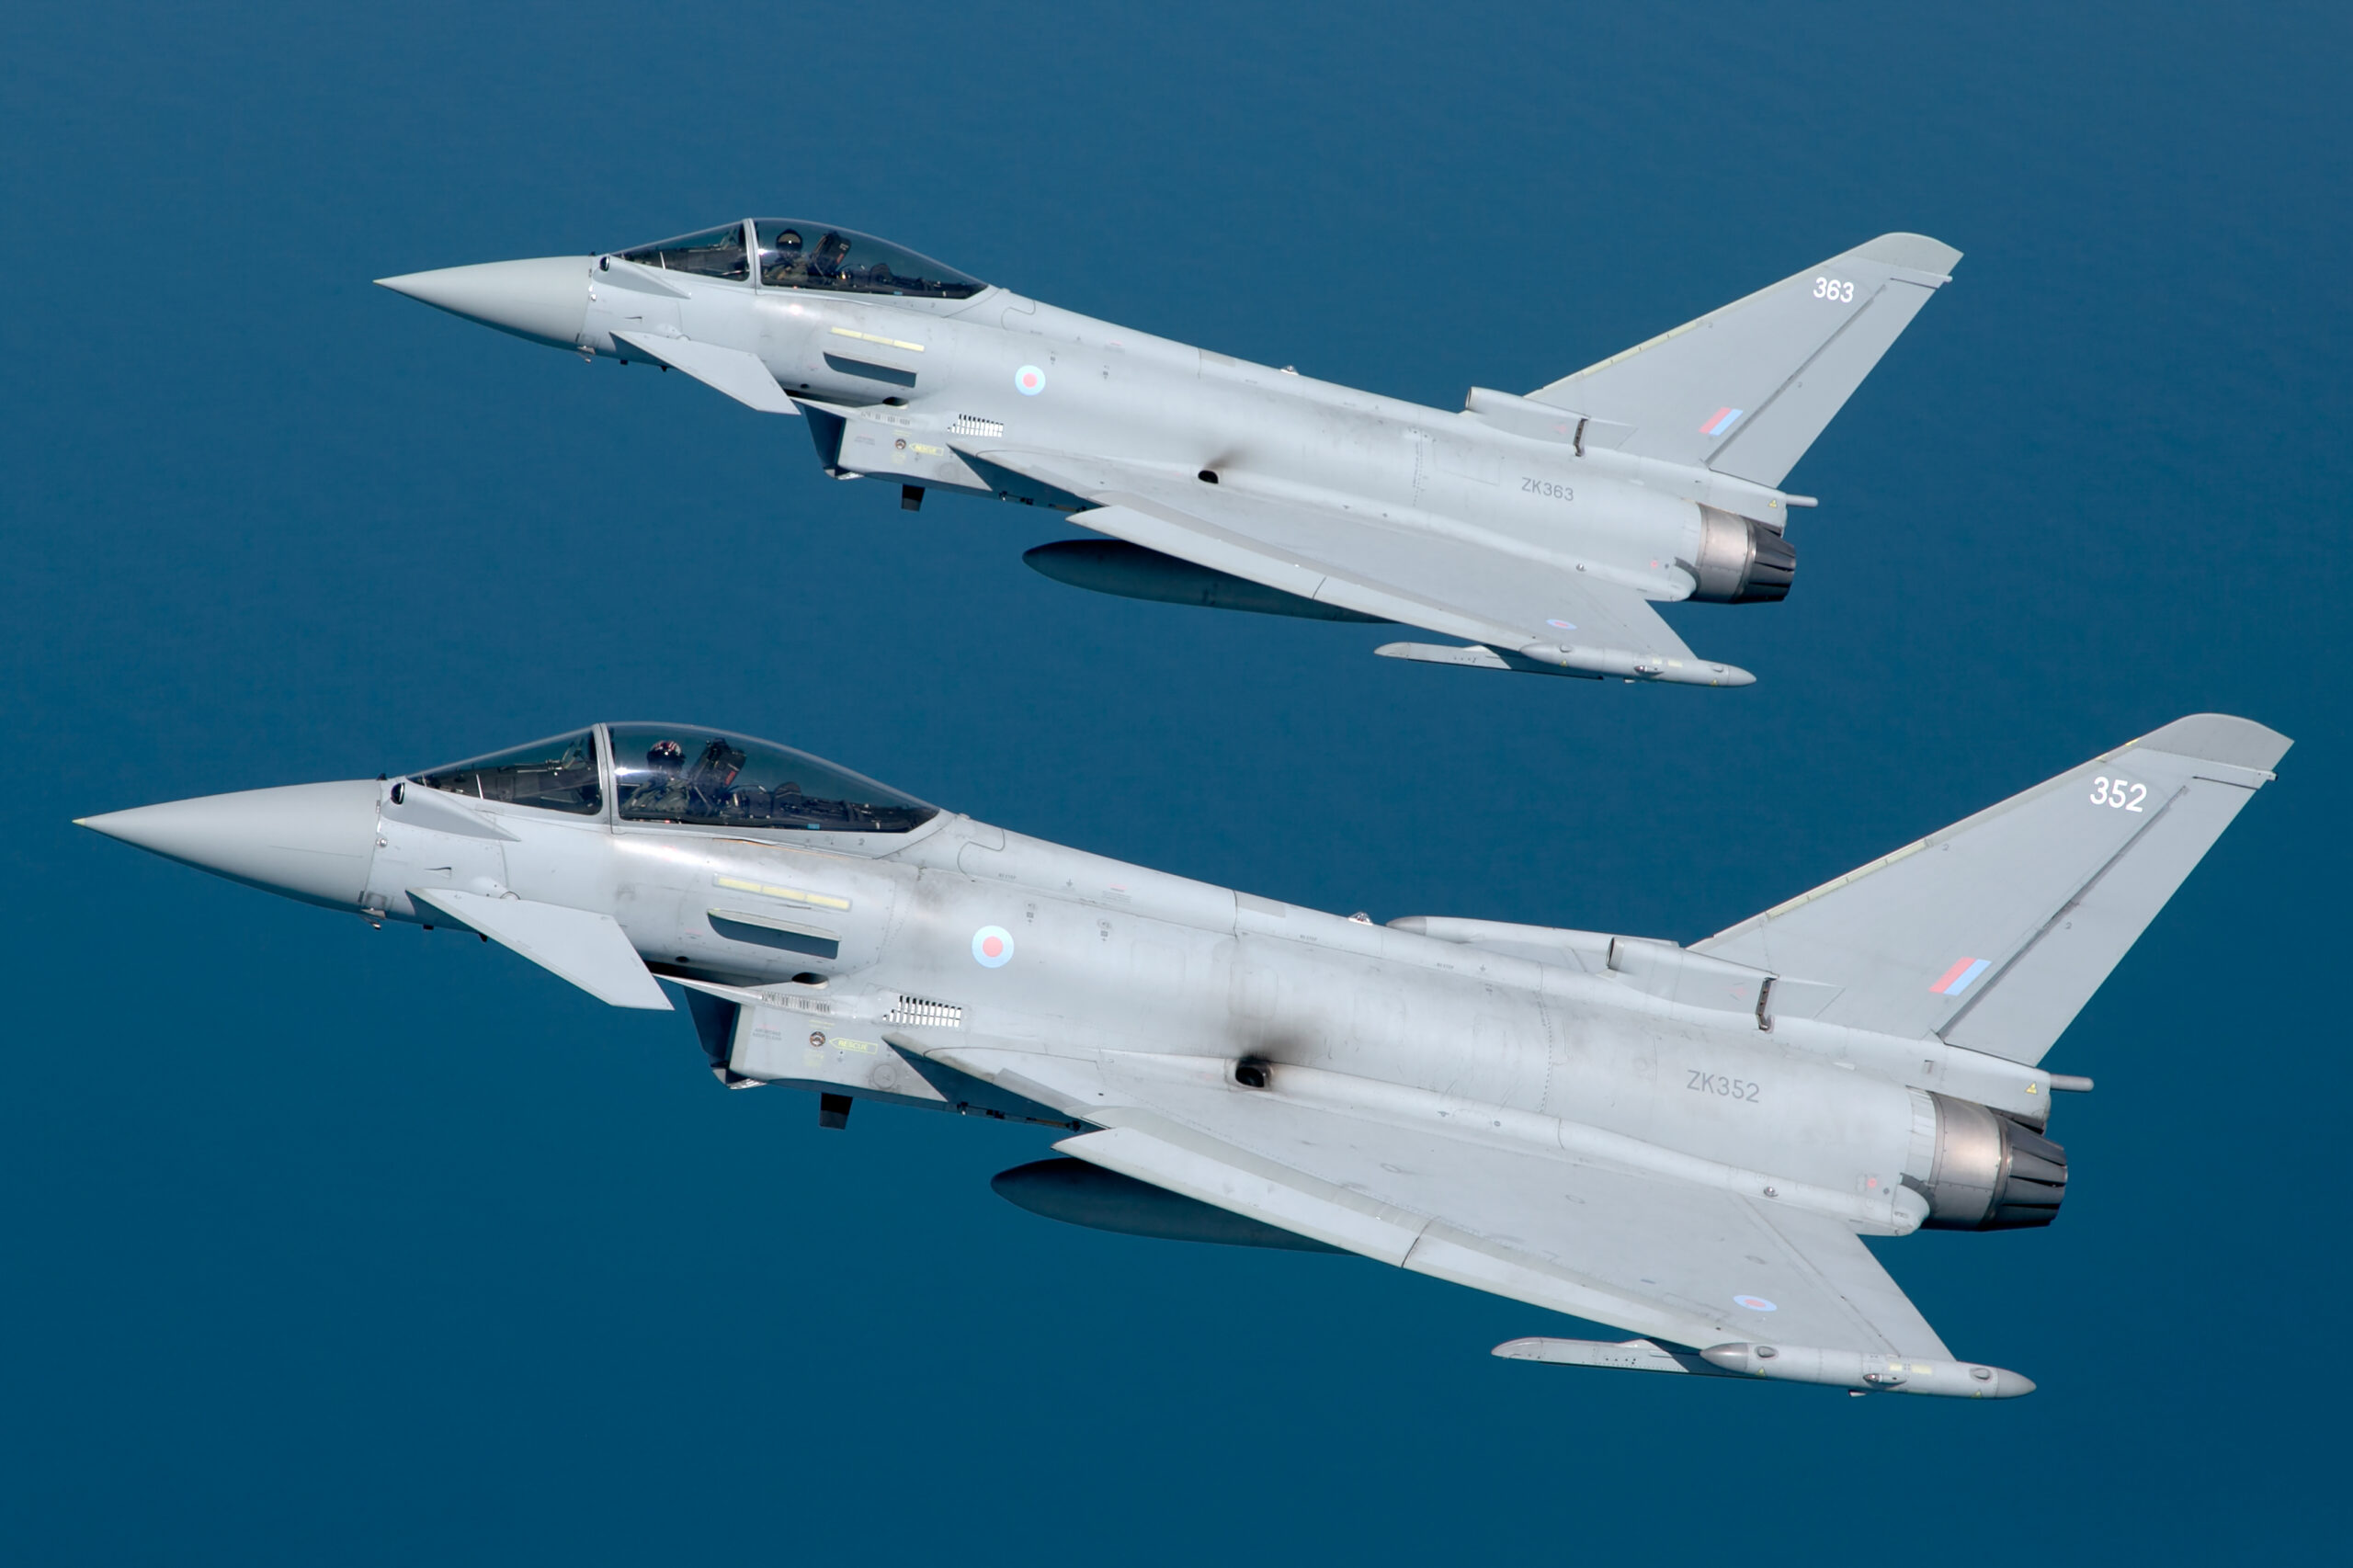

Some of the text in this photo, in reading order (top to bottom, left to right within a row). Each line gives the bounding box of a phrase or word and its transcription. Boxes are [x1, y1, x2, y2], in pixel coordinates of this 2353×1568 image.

[1813, 277, 1854, 303] 363
[1521, 476, 1574, 502] ZK363
[2089, 776, 2147, 812] 352
[1687, 1069, 1760, 1103] ZK352
